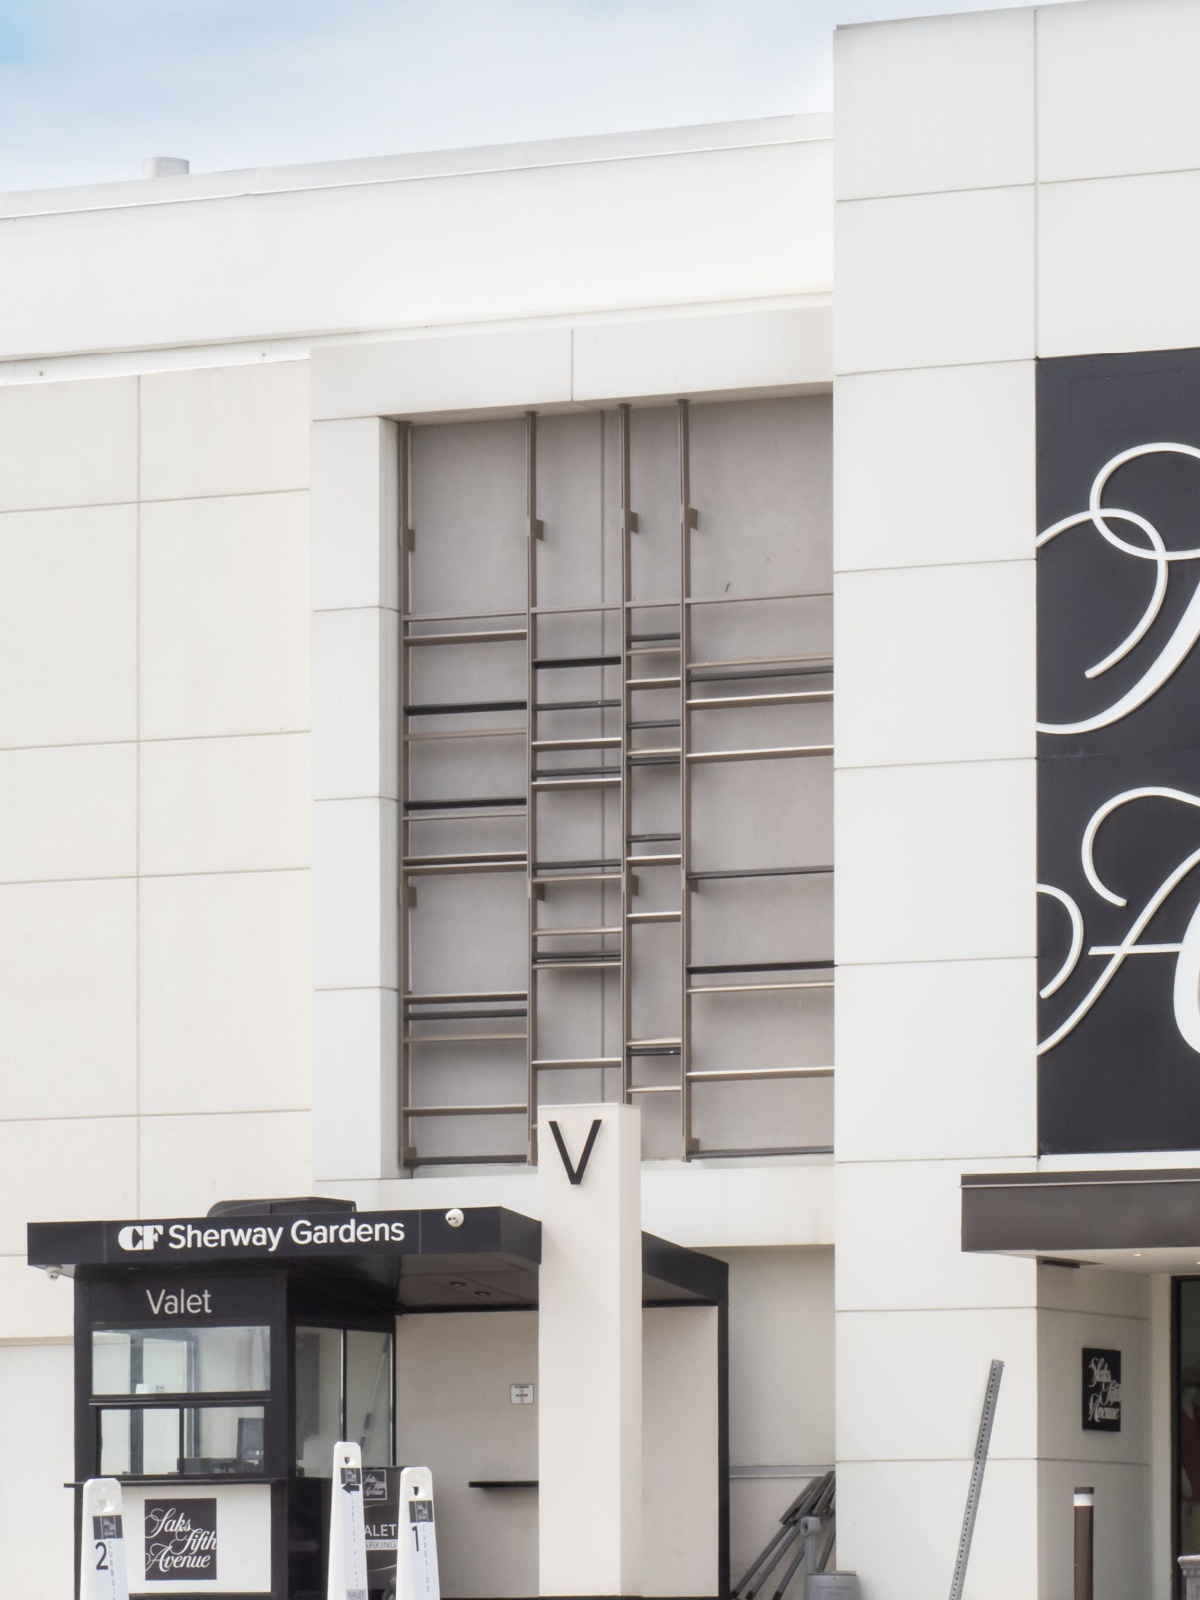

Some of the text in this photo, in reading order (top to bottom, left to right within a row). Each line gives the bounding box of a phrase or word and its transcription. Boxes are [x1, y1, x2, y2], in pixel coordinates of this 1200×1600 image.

[548, 1119, 602, 1185] V
[118, 1219, 405, 1252] CF Sherway Gardens
[146, 1289, 212, 1315] Valet
[145, 1508, 191, 1538] Saks
[364, 1524, 397, 1537] ALET
[170, 1528, 217, 1555] Fifth
[412, 1525, 419, 1552] 1
[95, 1541, 109, 1570] 2
[145, 1543, 211, 1573] Avenue
